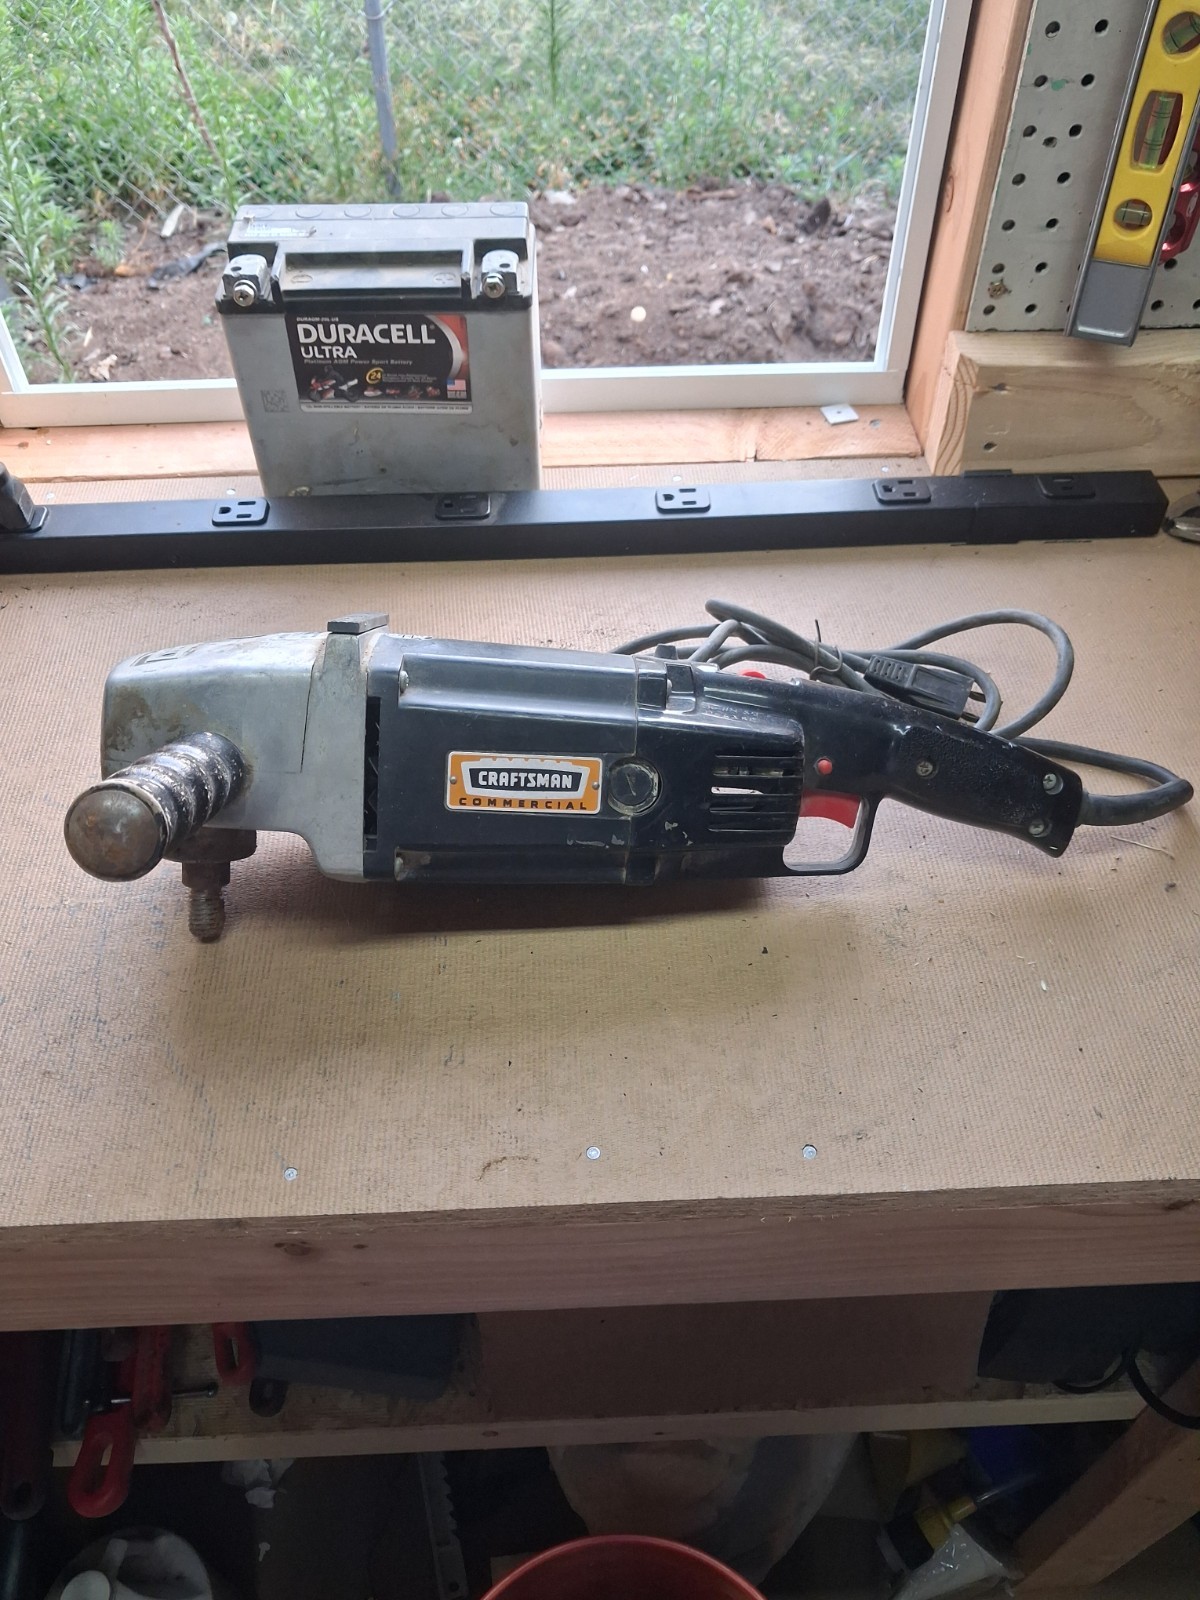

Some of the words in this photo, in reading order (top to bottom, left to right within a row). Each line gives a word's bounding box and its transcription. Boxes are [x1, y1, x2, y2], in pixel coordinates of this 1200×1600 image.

[297, 323, 436, 344] DURACELL
[300, 346, 358, 359] ULTRA
[370, 371, 382, 380] 24
[478, 770, 573, 789] CRAFTSMAN
[458, 797, 587, 811] COMMERCIAL
